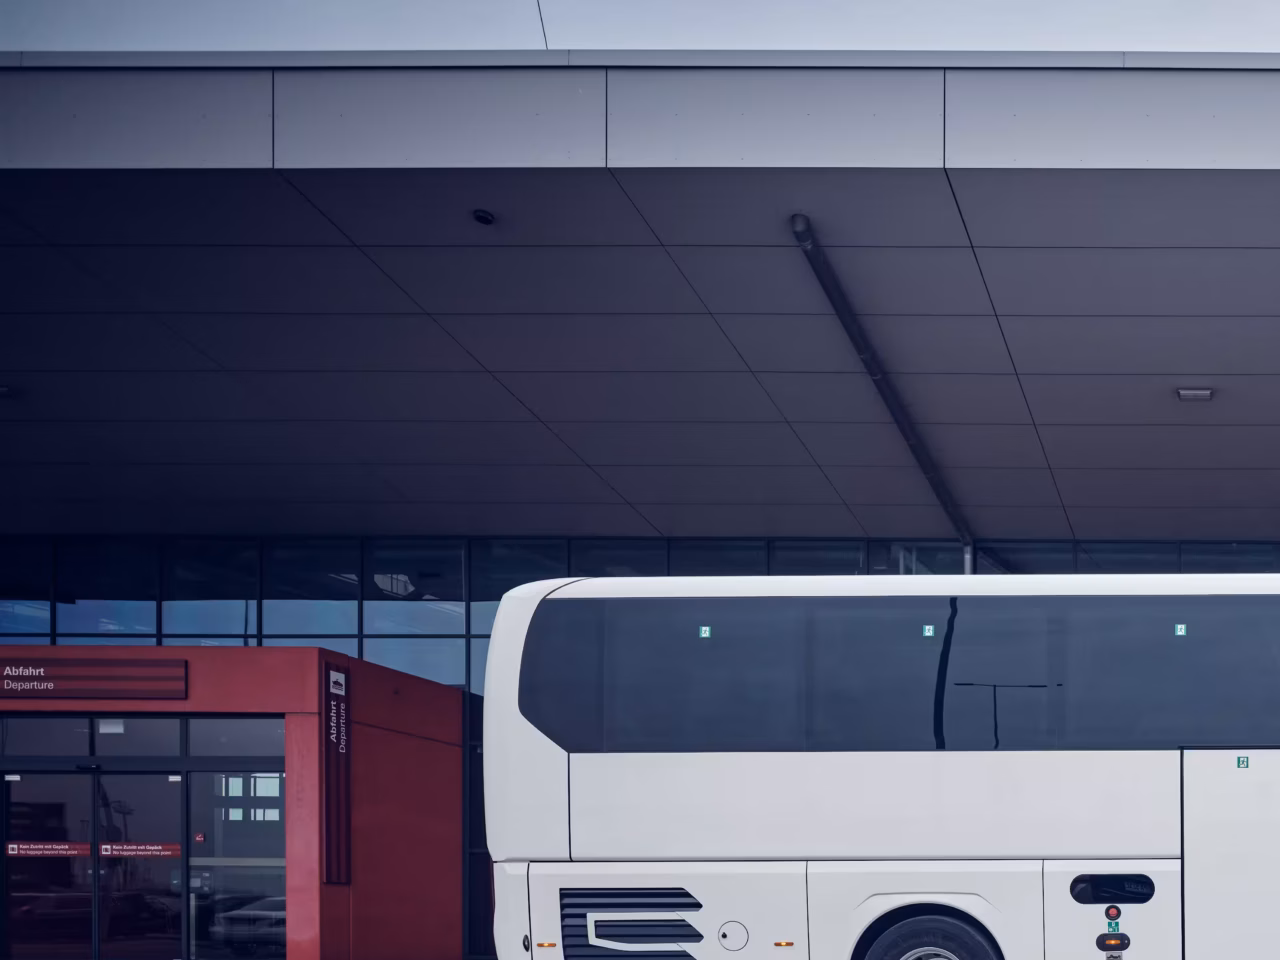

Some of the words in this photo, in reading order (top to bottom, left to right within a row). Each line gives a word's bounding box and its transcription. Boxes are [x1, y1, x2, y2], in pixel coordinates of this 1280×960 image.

[3, 666, 45, 676] Abfahrt
[4, 679, 54, 691] Departure
[339, 703, 347, 753] Departure
